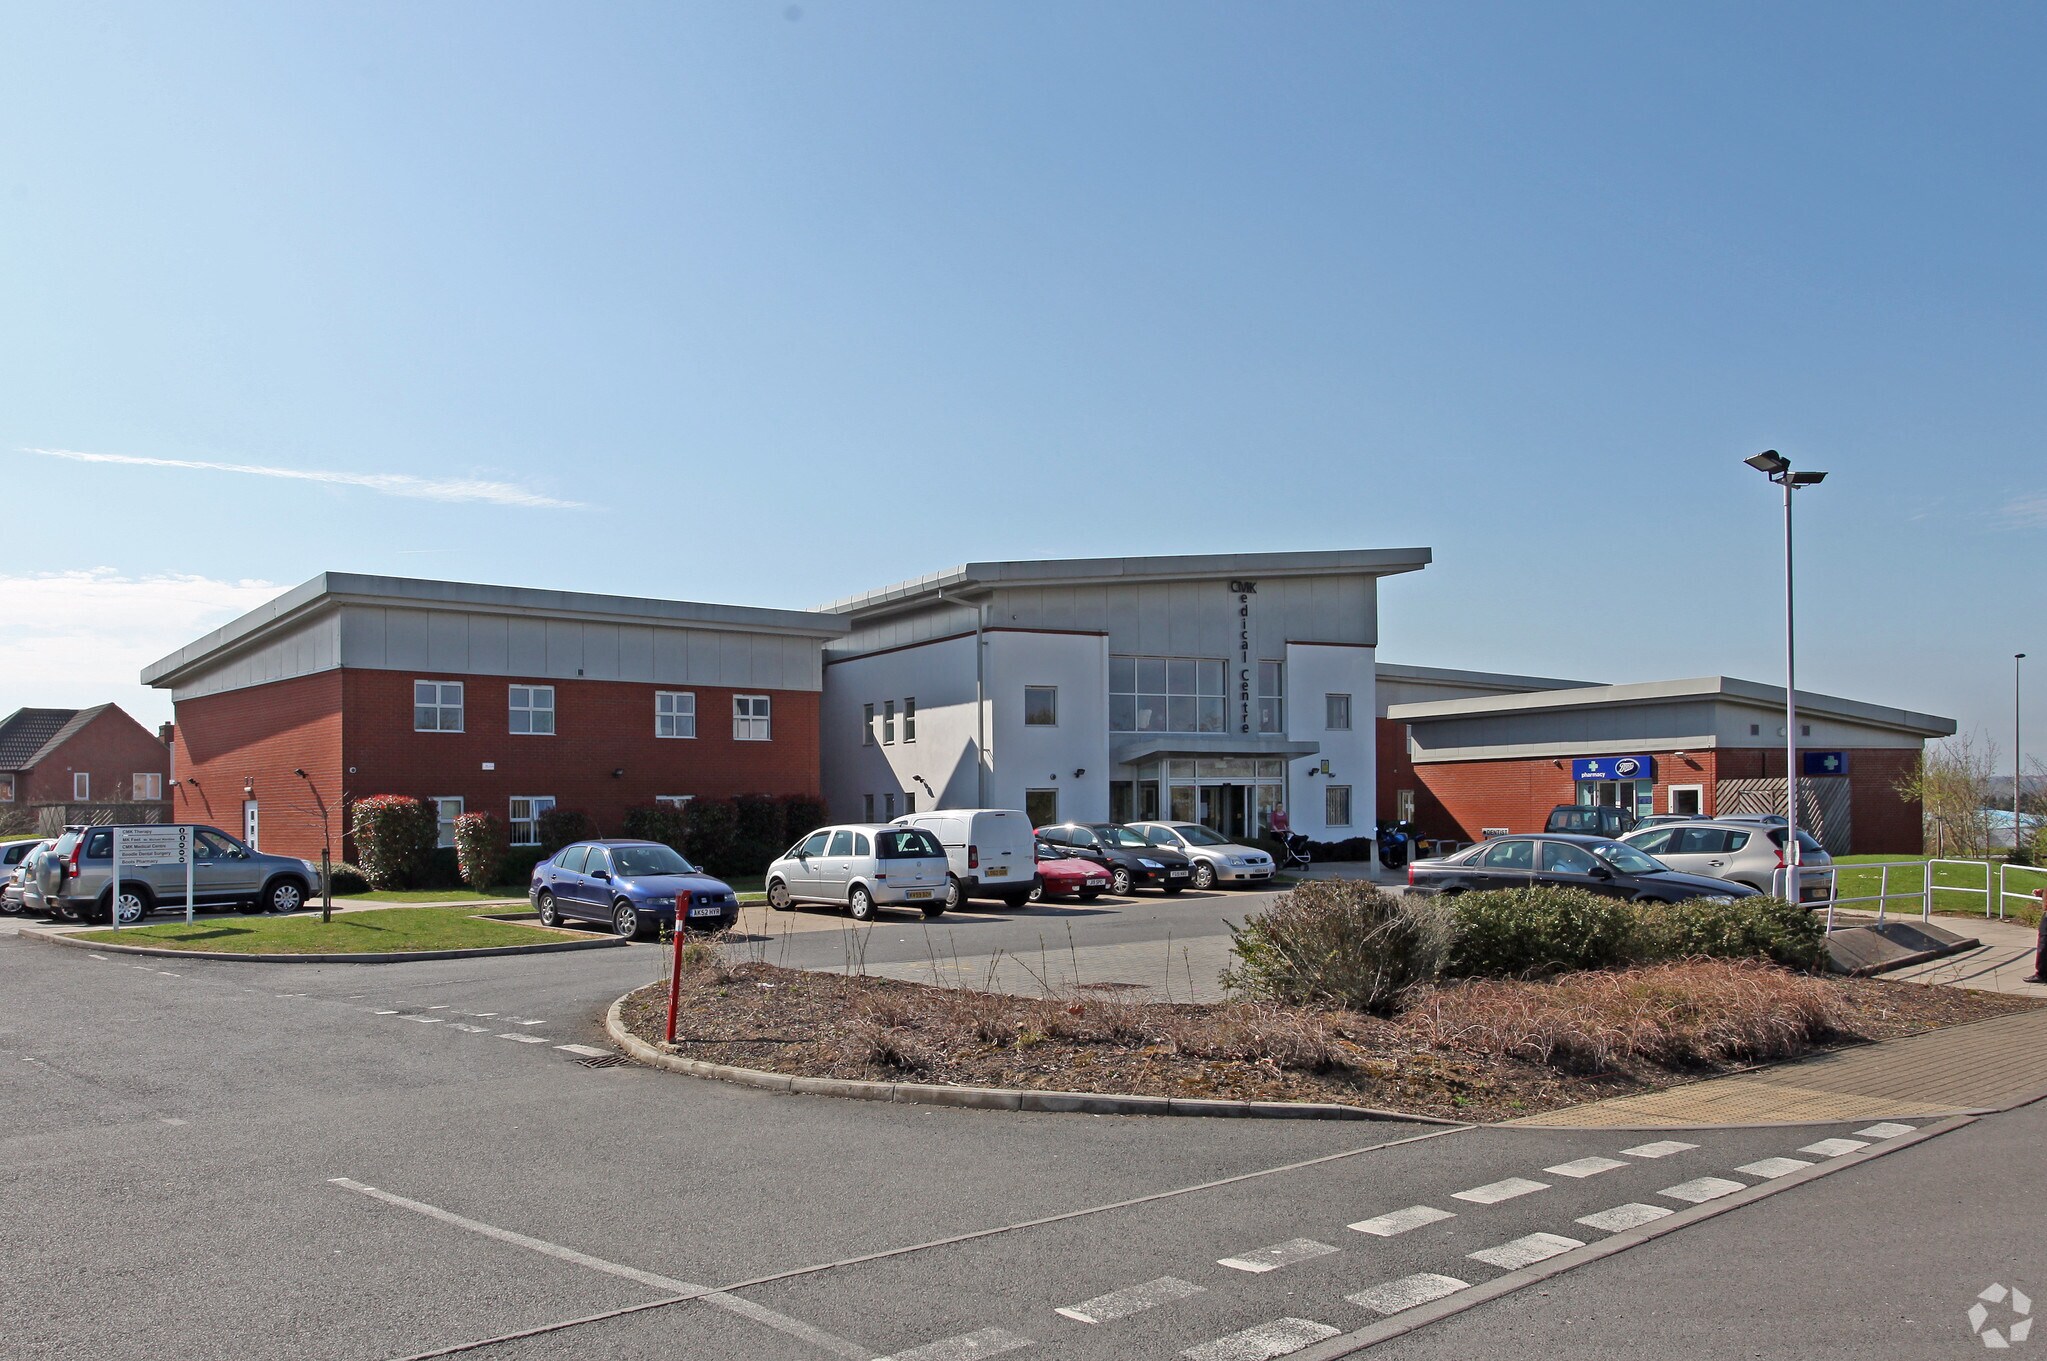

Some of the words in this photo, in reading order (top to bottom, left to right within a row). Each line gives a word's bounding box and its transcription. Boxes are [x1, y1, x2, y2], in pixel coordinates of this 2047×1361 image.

[1231, 580, 1257, 593] CMK
[1240, 669, 1249, 734] Centre
[1581, 771, 1605, 779] pharmacy
[693, 908, 708, 917] AK52
